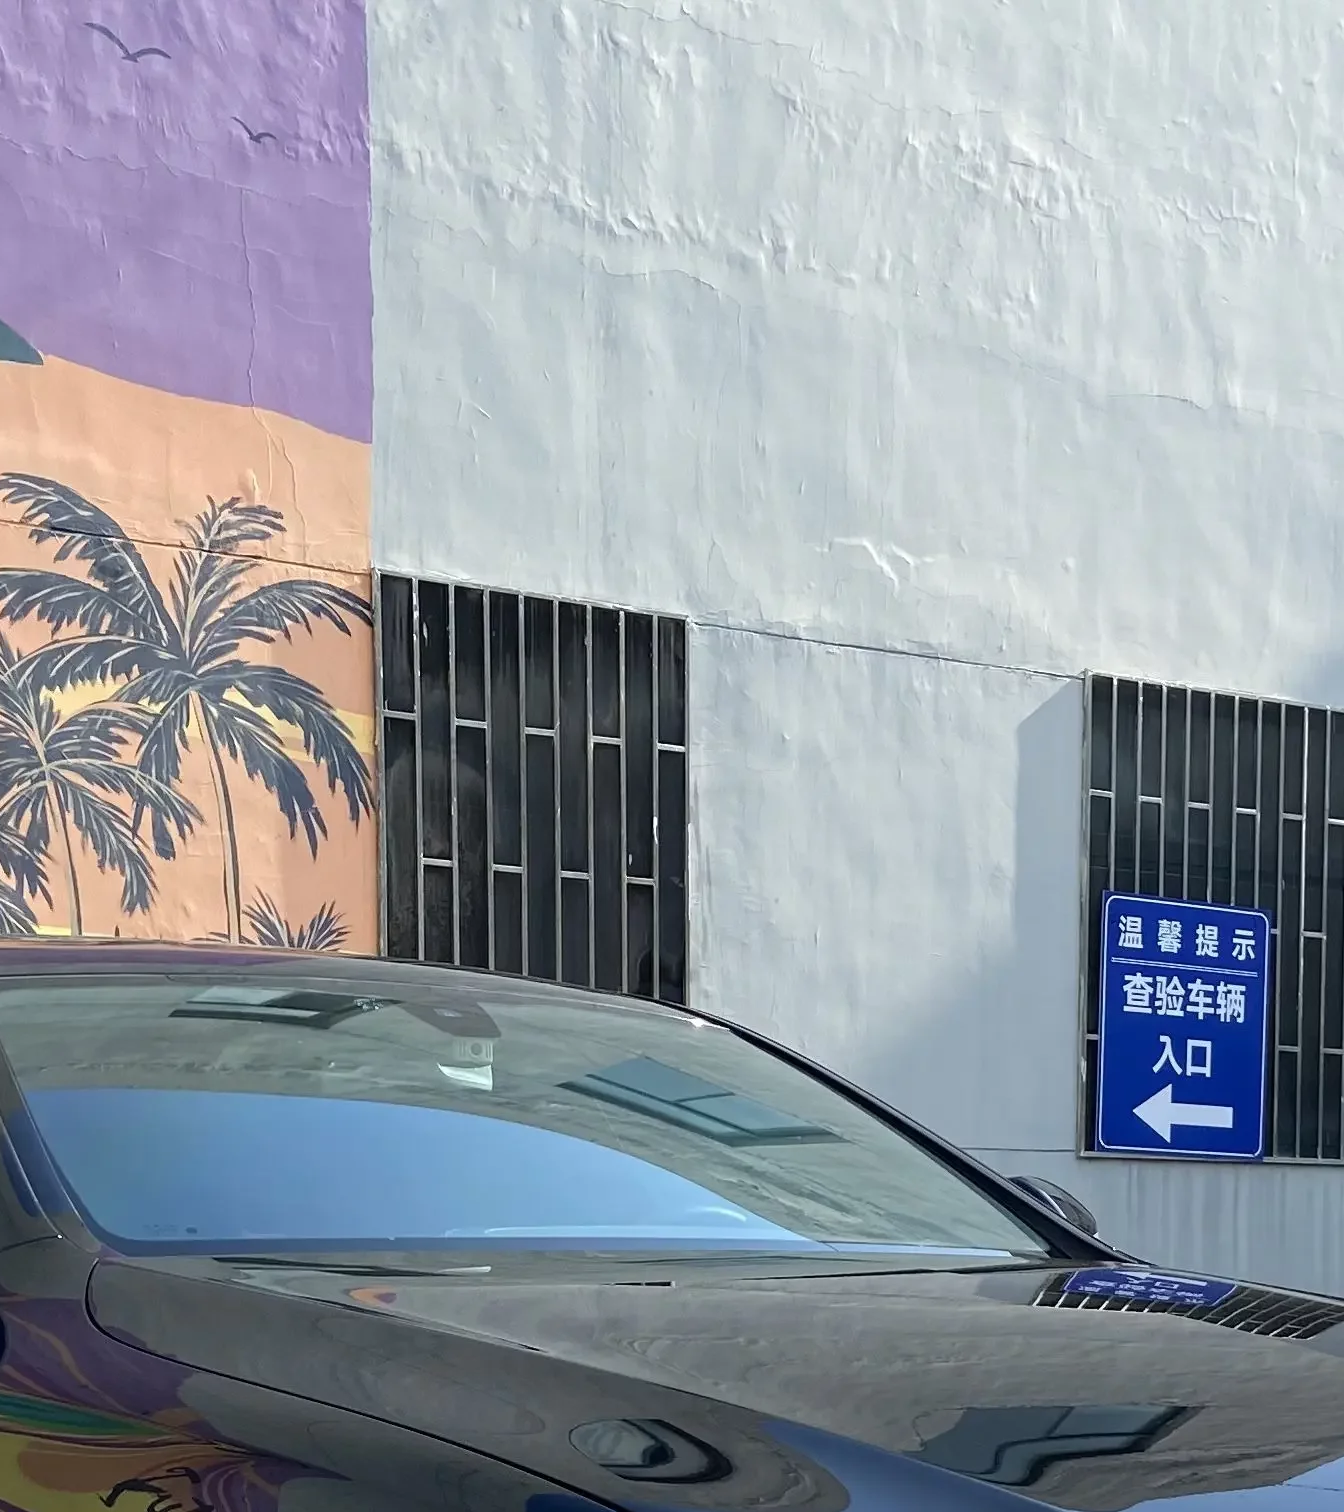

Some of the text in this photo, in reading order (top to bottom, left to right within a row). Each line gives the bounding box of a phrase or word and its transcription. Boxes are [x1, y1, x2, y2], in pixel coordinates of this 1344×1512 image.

[1117, 914, 1256, 961] 温馨提示
[1122, 971, 1246, 1024] 查验车辆
[1152, 1034, 1212, 1078] 入口
